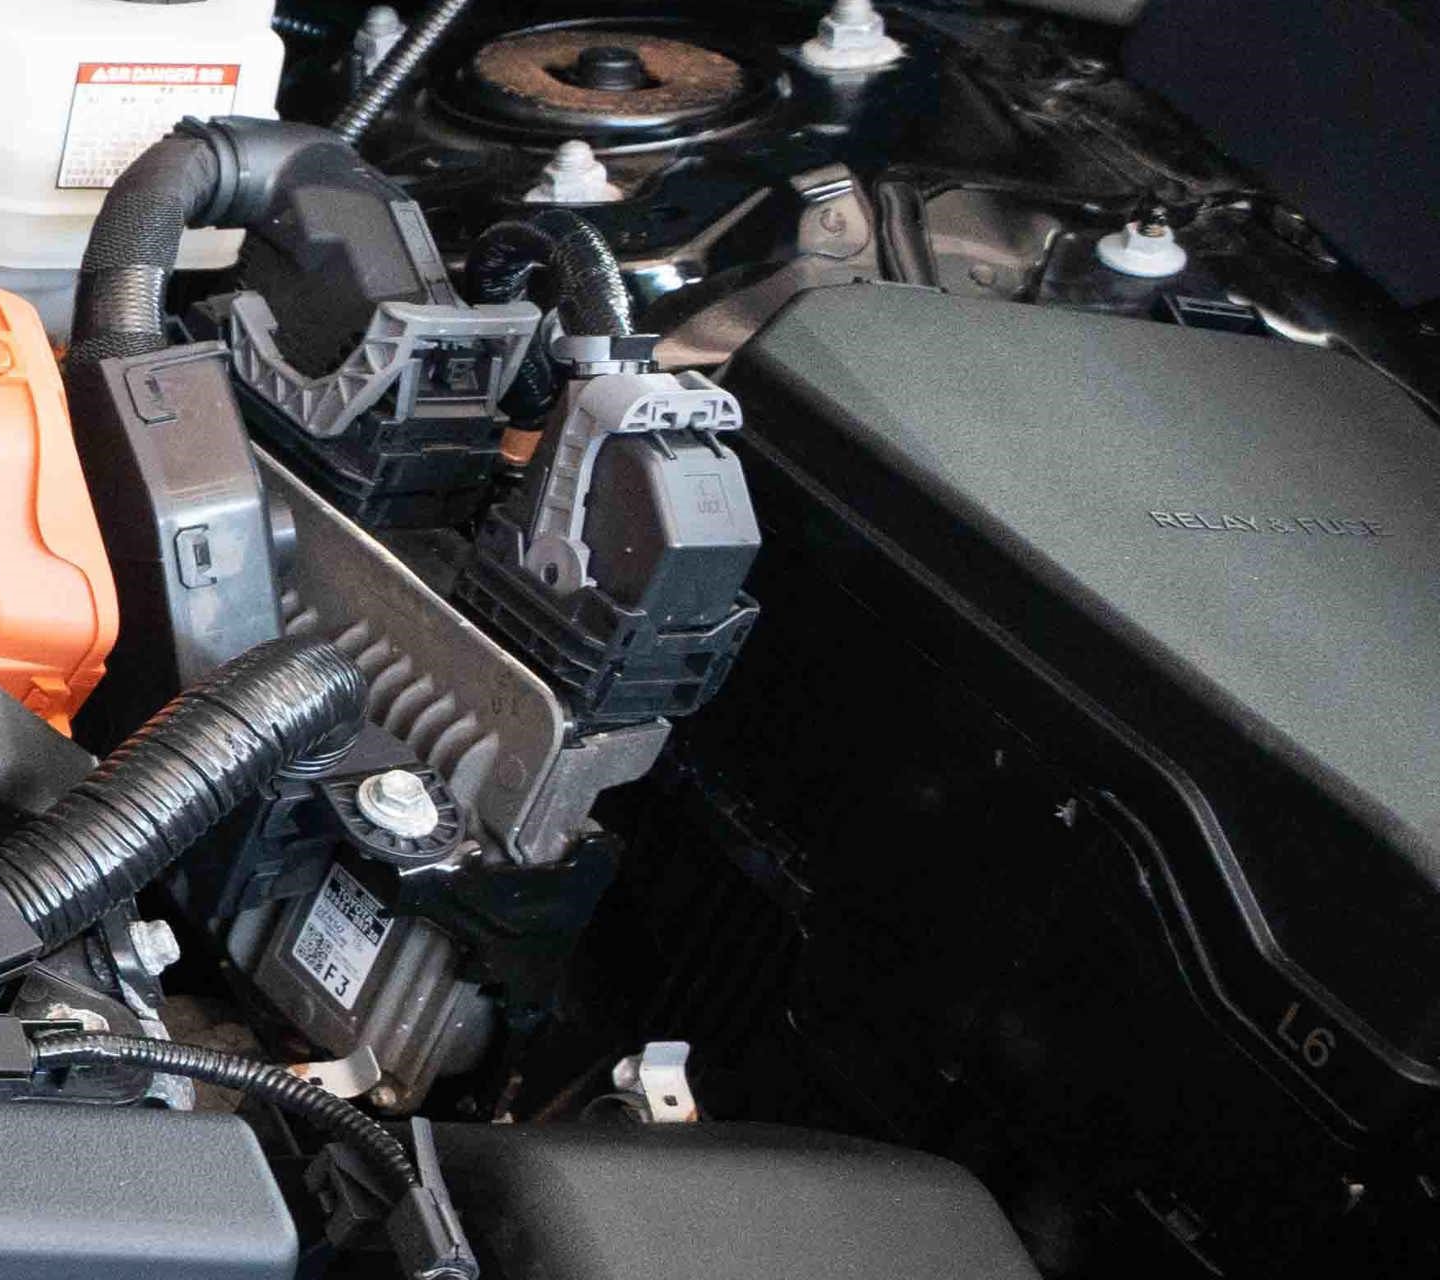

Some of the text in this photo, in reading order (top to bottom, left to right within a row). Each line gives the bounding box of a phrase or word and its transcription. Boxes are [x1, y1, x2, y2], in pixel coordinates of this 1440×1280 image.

[1147, 511, 1394, 536] RELAY & FUSE
[1274, 1003, 1338, 1069] L6
